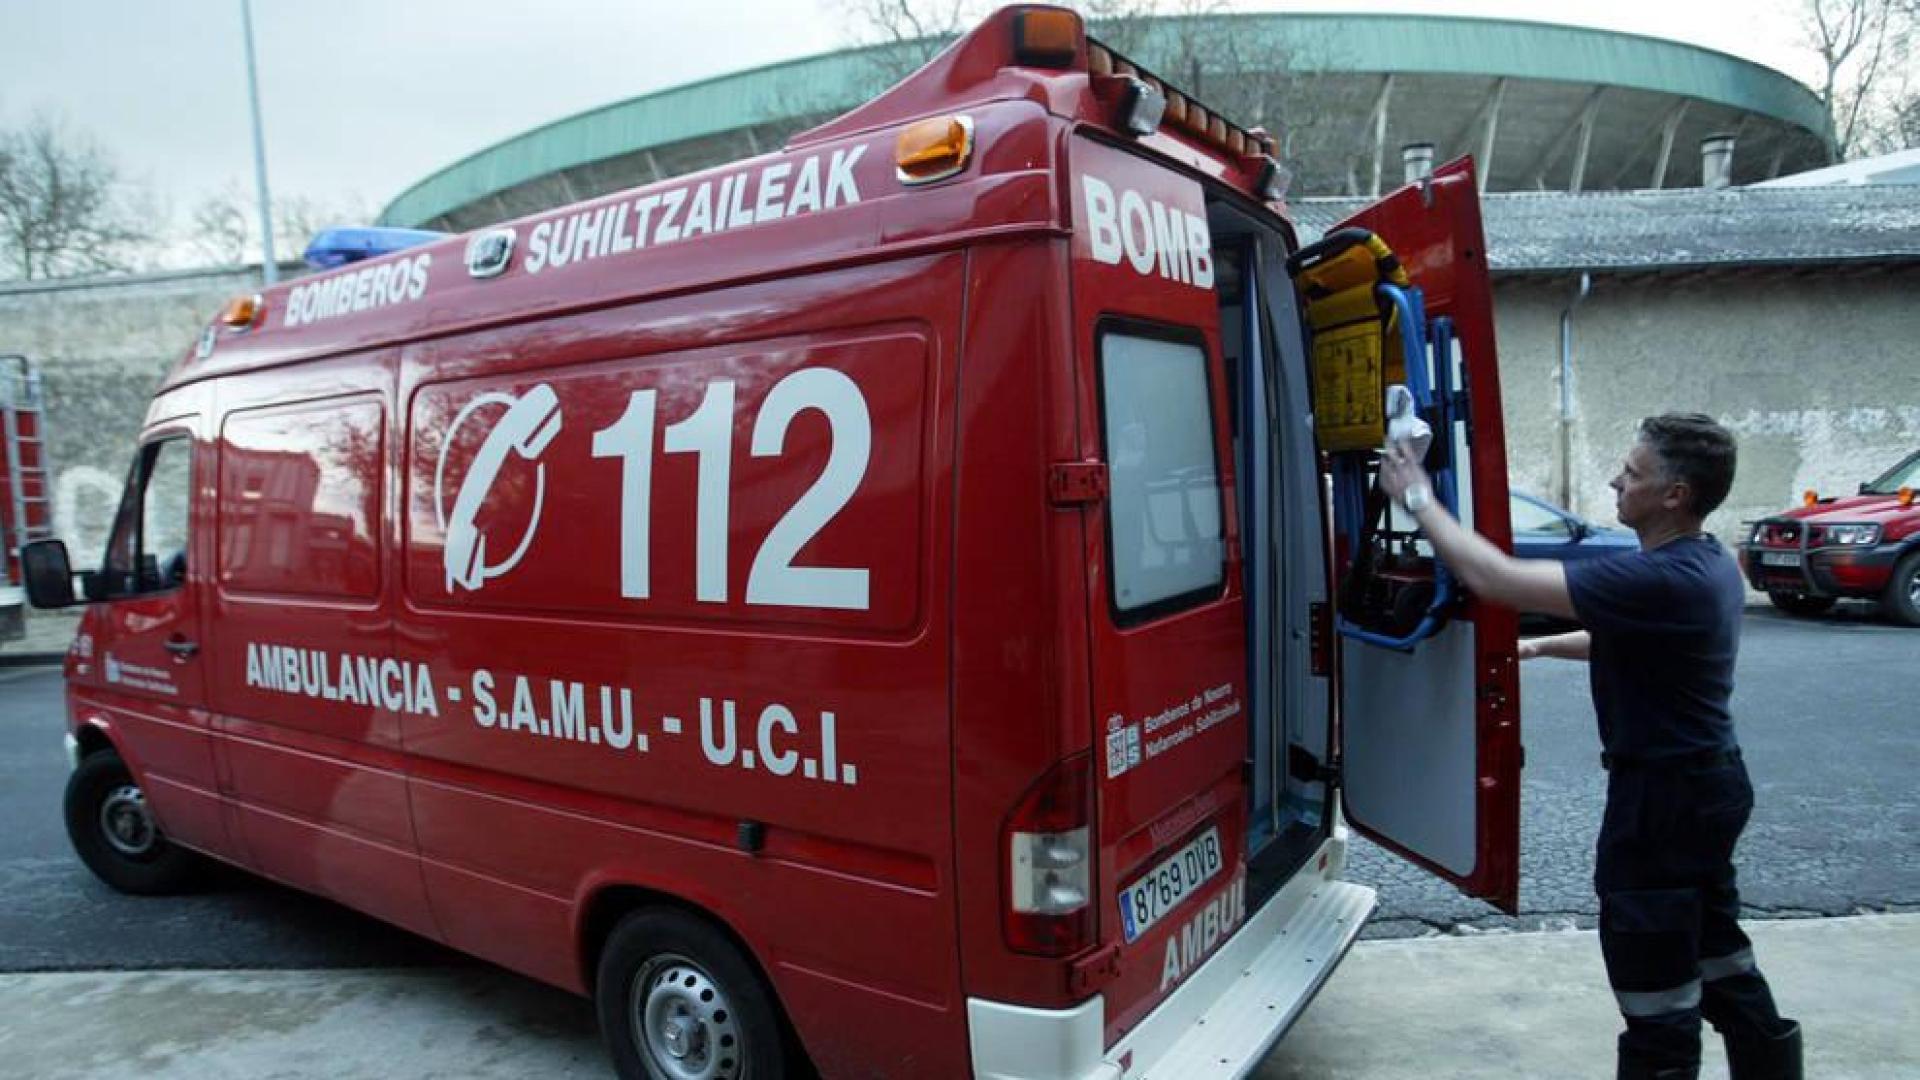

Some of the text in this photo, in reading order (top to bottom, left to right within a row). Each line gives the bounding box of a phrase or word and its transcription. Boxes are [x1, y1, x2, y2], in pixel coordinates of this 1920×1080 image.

[524, 143, 869, 274] SUHILTZAILEAK
[1082, 173, 1215, 289] BOMB
[284, 253, 432, 327] BOMBEROS
[591, 366, 872, 610] 112
[247, 642, 439, 718] AMBULANCIA
[471, 668, 649, 753] S.A.M.U.
[699, 696, 857, 785] U.C.I.
[1135, 836, 1219, 925] 8769 DVB
